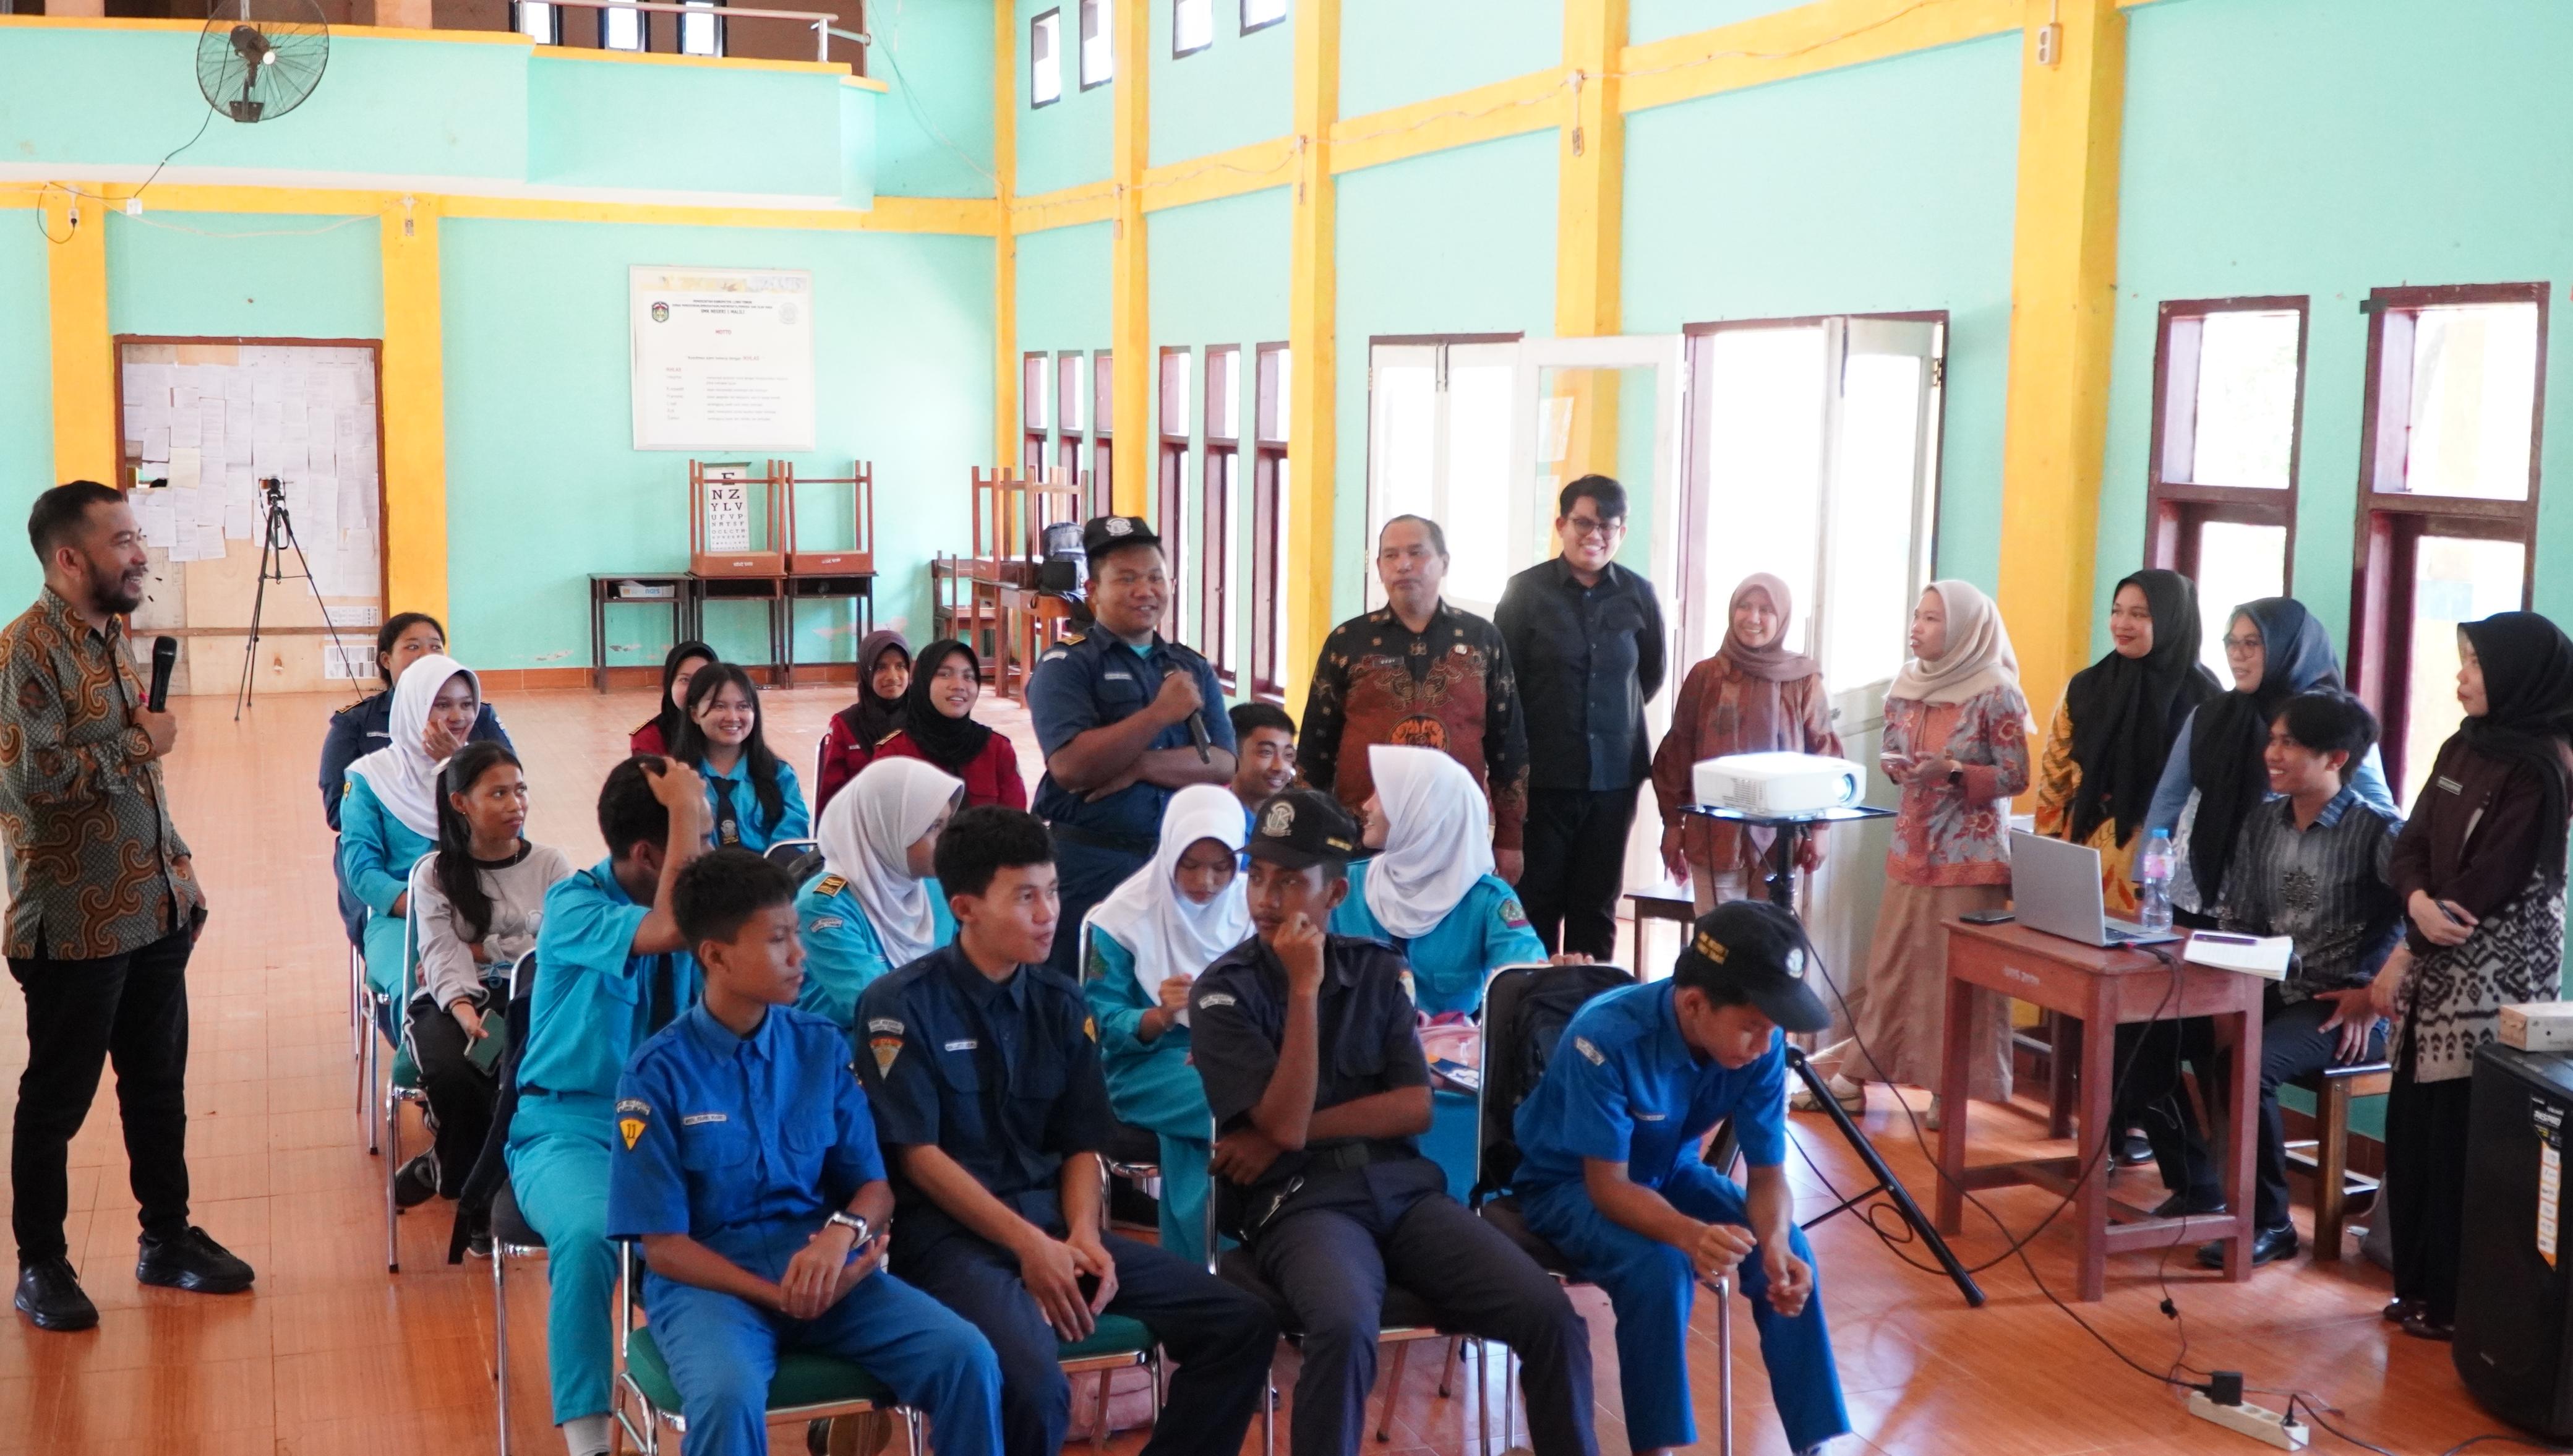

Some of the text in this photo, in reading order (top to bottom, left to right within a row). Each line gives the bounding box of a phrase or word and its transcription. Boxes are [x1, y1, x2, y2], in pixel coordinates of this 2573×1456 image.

[712, 489, 740, 500] N Z
[711, 502, 743, 512] Y L V
